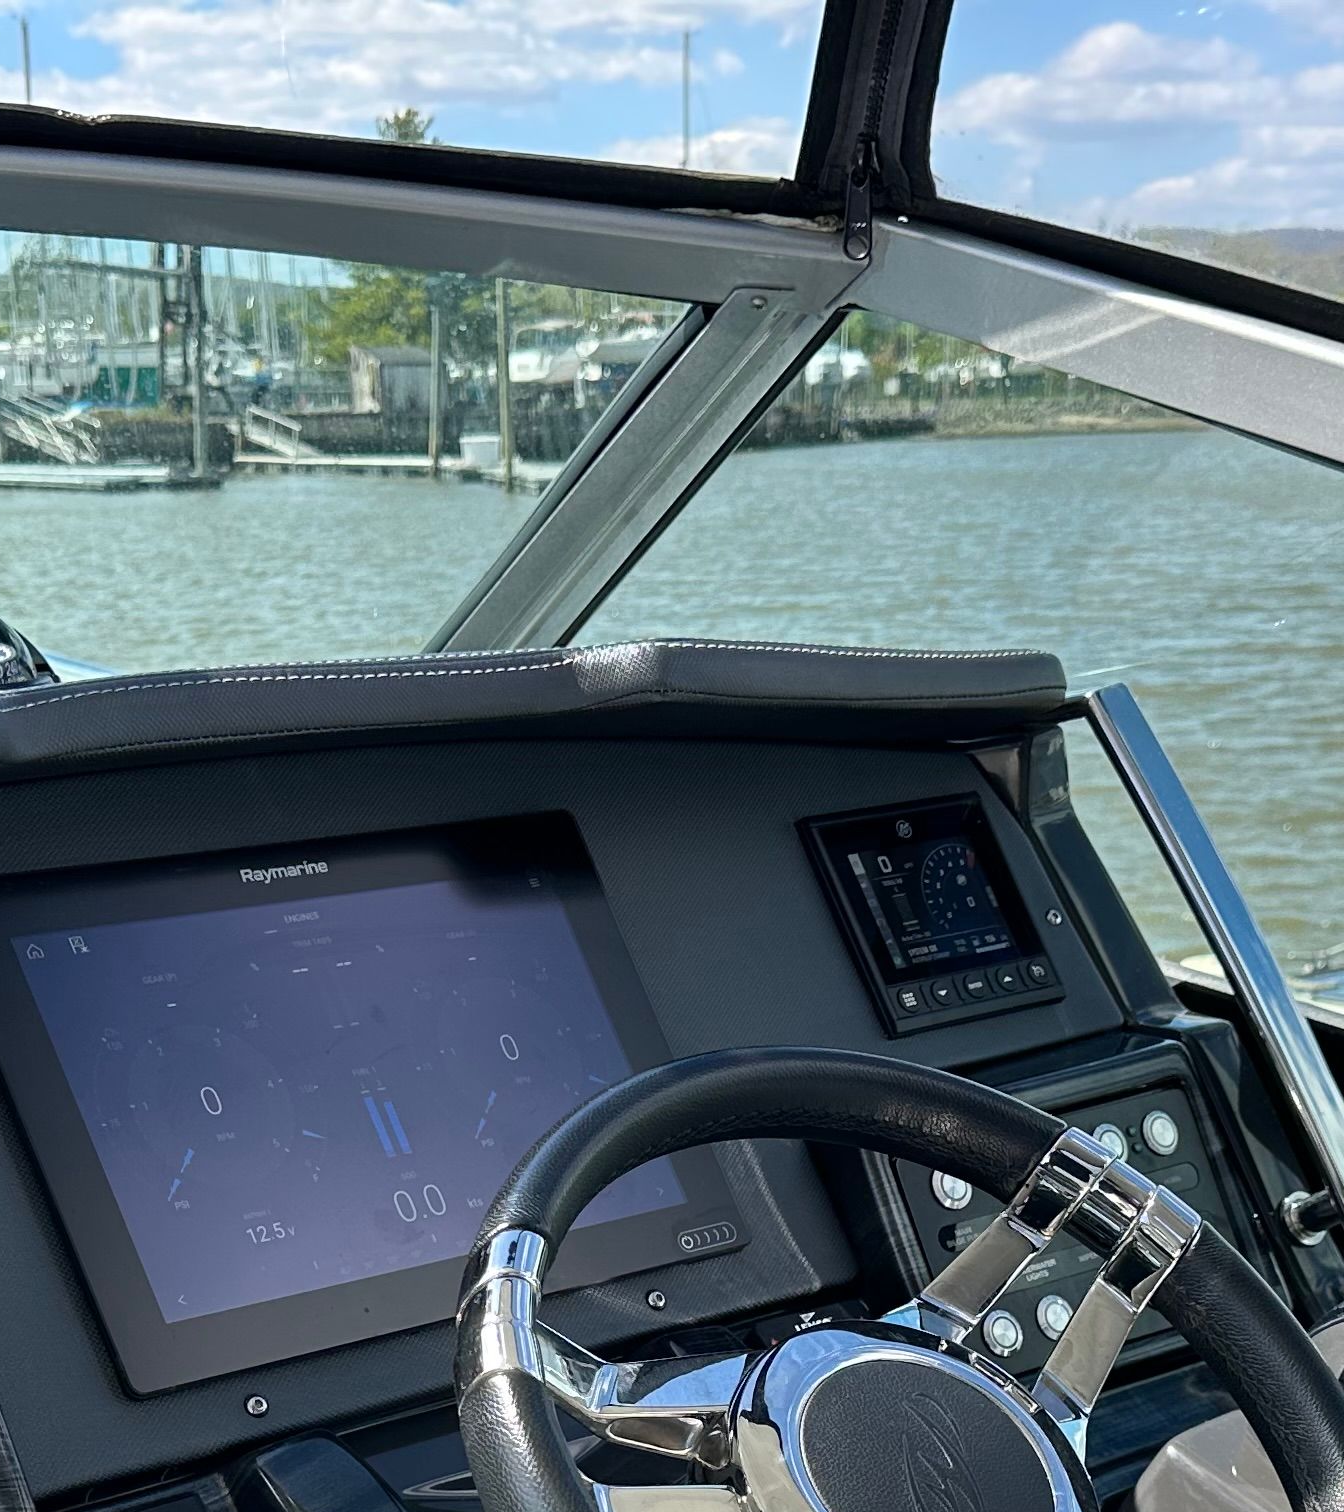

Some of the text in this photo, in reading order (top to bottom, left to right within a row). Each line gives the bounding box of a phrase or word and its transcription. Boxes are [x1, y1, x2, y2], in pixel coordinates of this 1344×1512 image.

[240, 860, 329, 884] Raymarine
[877, 855, 893, 874] 0
[499, 1033, 519, 1062] 0
[199, 1085, 224, 1117] 0
[173, 1199, 191, 1211] PSI
[393, 1184, 447, 1223] 0.0
